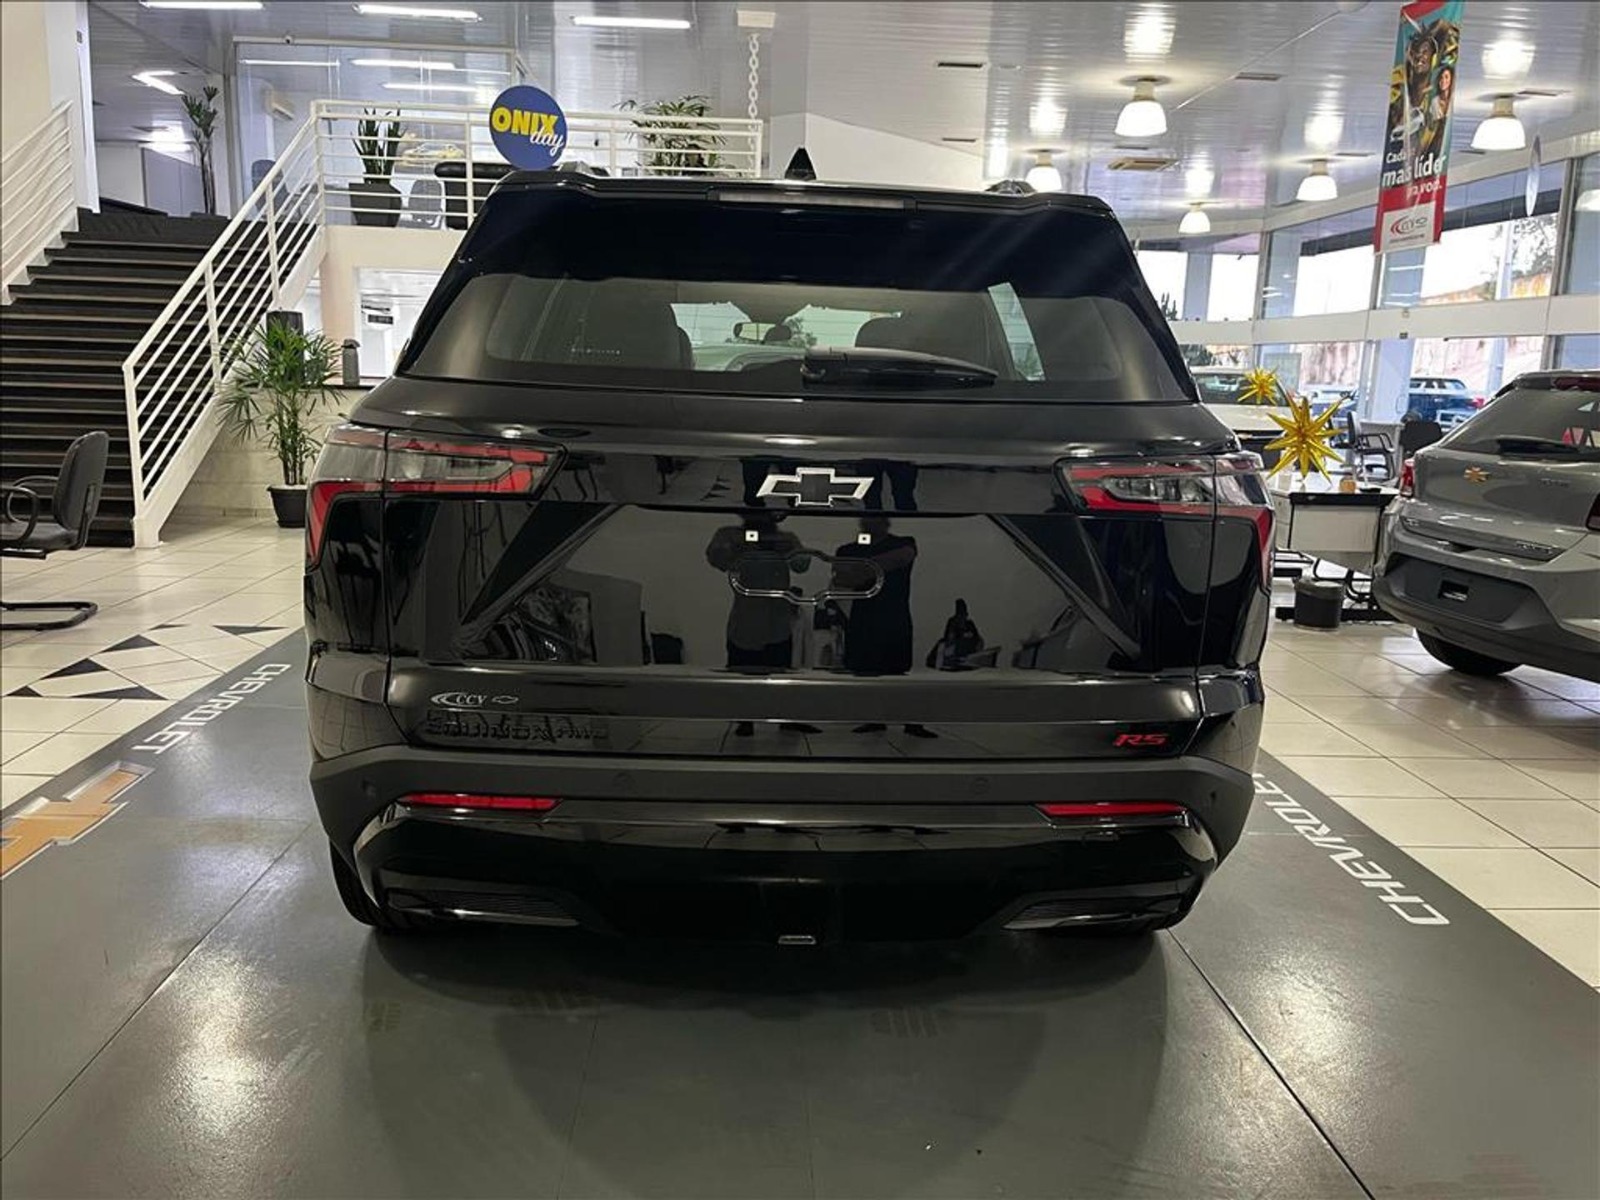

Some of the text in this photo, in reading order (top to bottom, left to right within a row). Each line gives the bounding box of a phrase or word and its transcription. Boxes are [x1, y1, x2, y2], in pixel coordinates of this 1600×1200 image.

[491, 107, 559, 136] ONIX
[530, 125, 565, 157] day
[132, 663, 291, 754] CHEVROLET
[1113, 733, 1169, 747] RS
